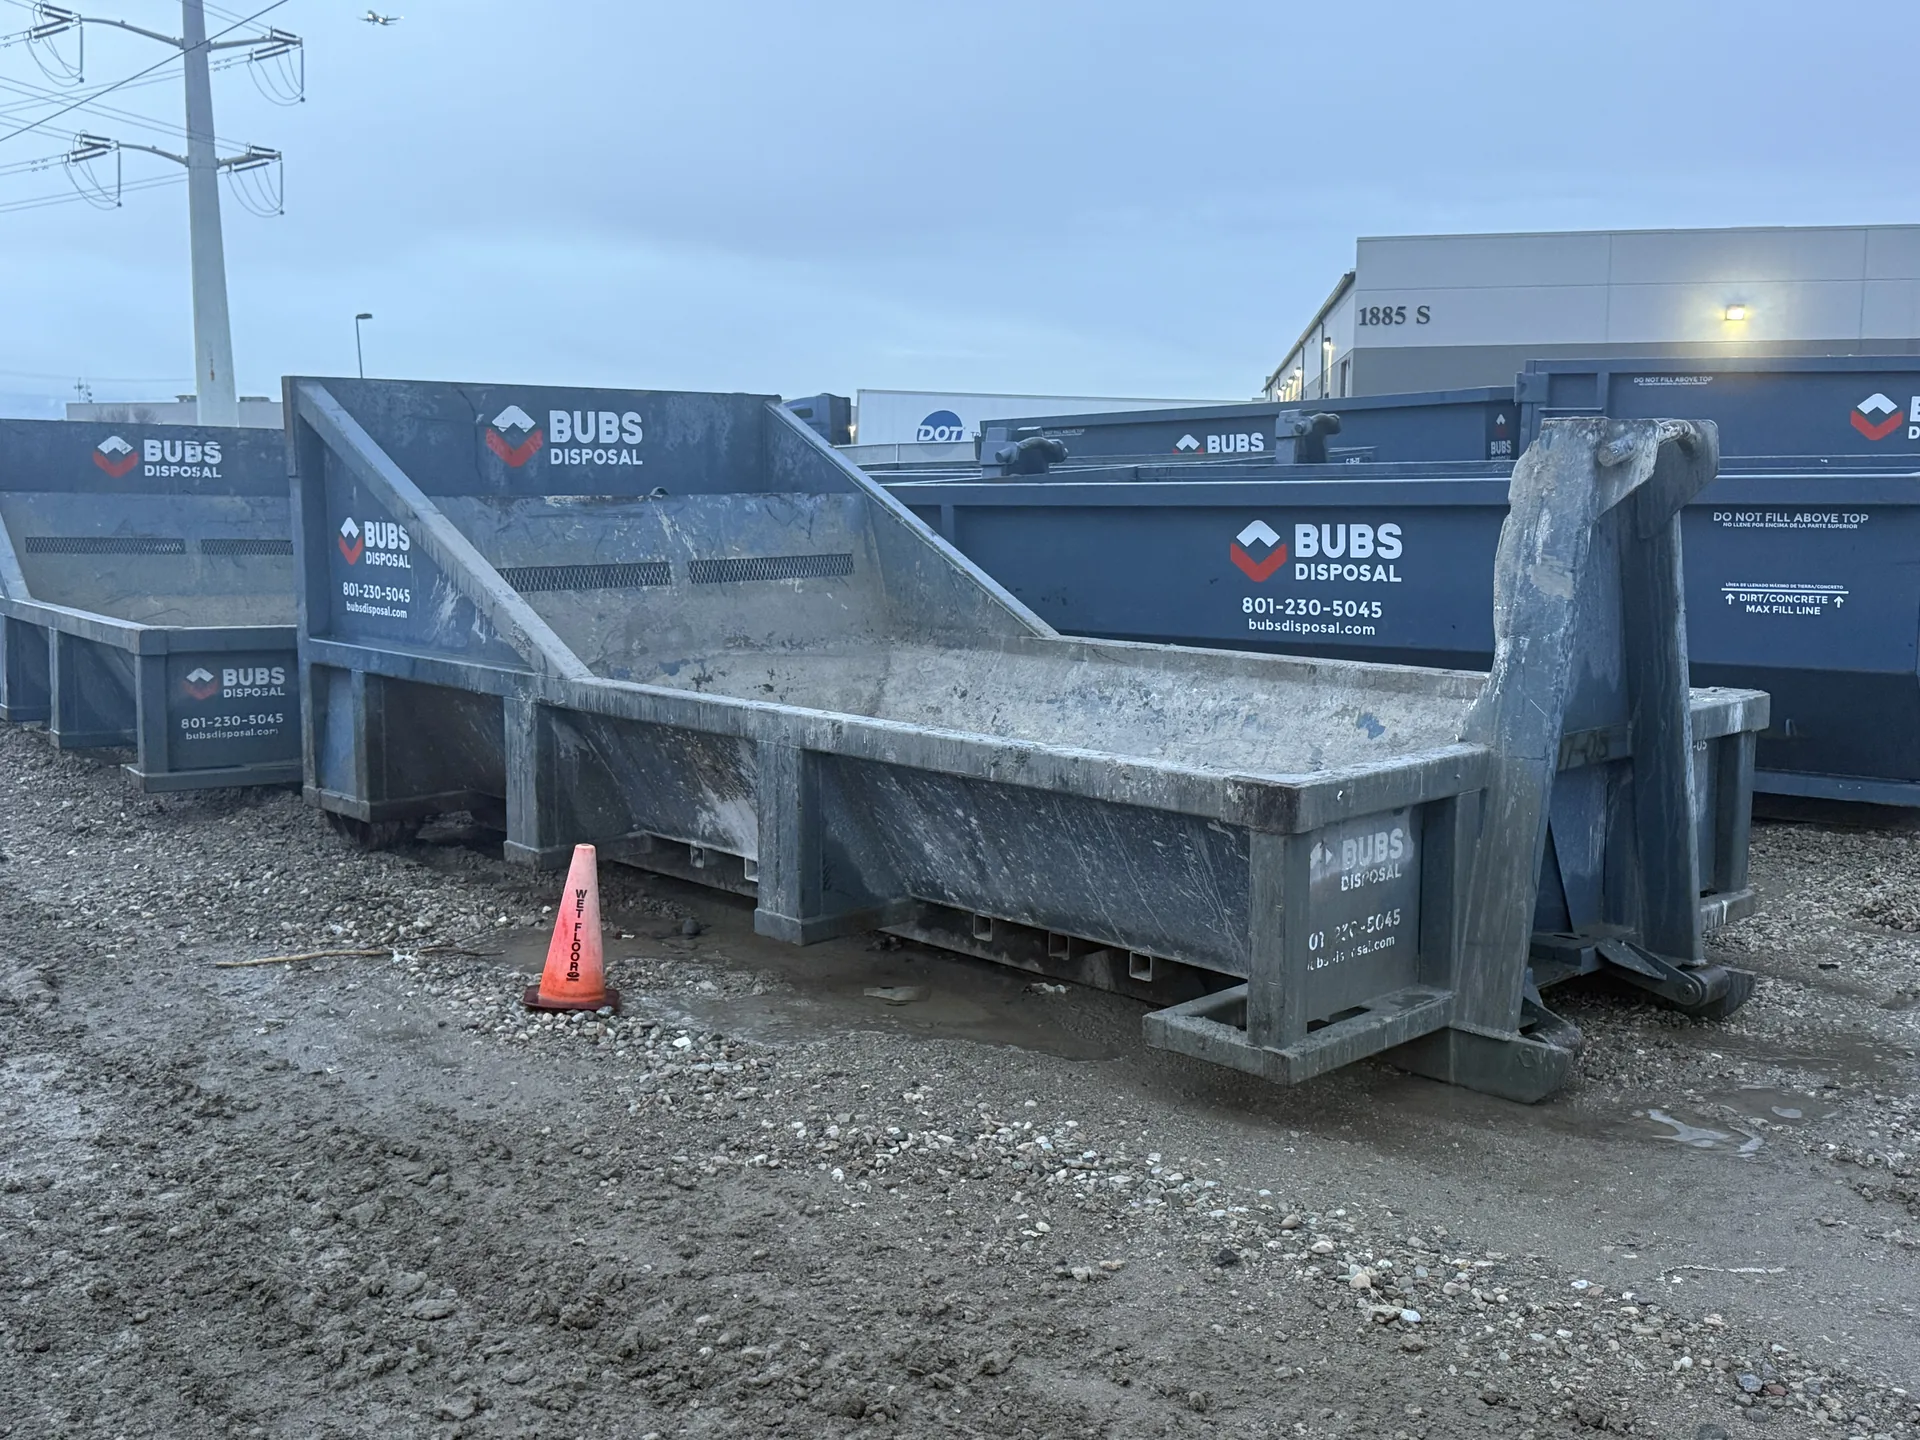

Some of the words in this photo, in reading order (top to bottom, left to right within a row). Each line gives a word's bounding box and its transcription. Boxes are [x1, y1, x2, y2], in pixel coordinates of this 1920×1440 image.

[1359, 306, 1407, 326] 1885
[1416, 305, 1431, 325] S
[549, 410, 643, 445] BUBS
[918, 425, 965, 441] DOT
[143, 439, 222, 465] BUBS
[1207, 432, 1265, 454] BUBS
[1490, 440, 1511, 455] BUBS
[550, 448, 643, 465] DISPOSAL
[144, 465, 222, 478] DISPOSAL
[1713, 512, 1732, 521] DO
[1735, 512, 1763, 522] NOT
[1765, 512, 1791, 522] FILL
[1793, 513, 1839, 523] ABOVE
[1842, 513, 1869, 523] TOP
[364, 521, 411, 551] BUBS
[1295, 523, 1403, 560] BUBS
[365, 551, 411, 568] DISPOSAL
[1295, 563, 1402, 582] DISPOSAL
[342, 582, 411, 603] 801-230-5045
[1740, 593, 1828, 604] DIRT/CONCRETE
[346, 601, 408, 619] bubsdisposal.com
[1242, 597, 1383, 618] 801-230-5045
[1745, 605, 1770, 614] MAX
[1773, 605, 1794, 614] FILL
[1796, 606, 1821, 615] LINE
[1248, 618, 1376, 636] bubsdisposal.com
[222, 666, 286, 687] BUBS
[223, 687, 286, 698] DISPOSAL
[181, 713, 284, 729] 801-230-5045
[186, 728, 279, 740] bubsdisposal.com
[1342, 828, 1404, 871] BUBS
[576, 889, 587, 918] WET
[570, 923, 582, 971] FLOOR
